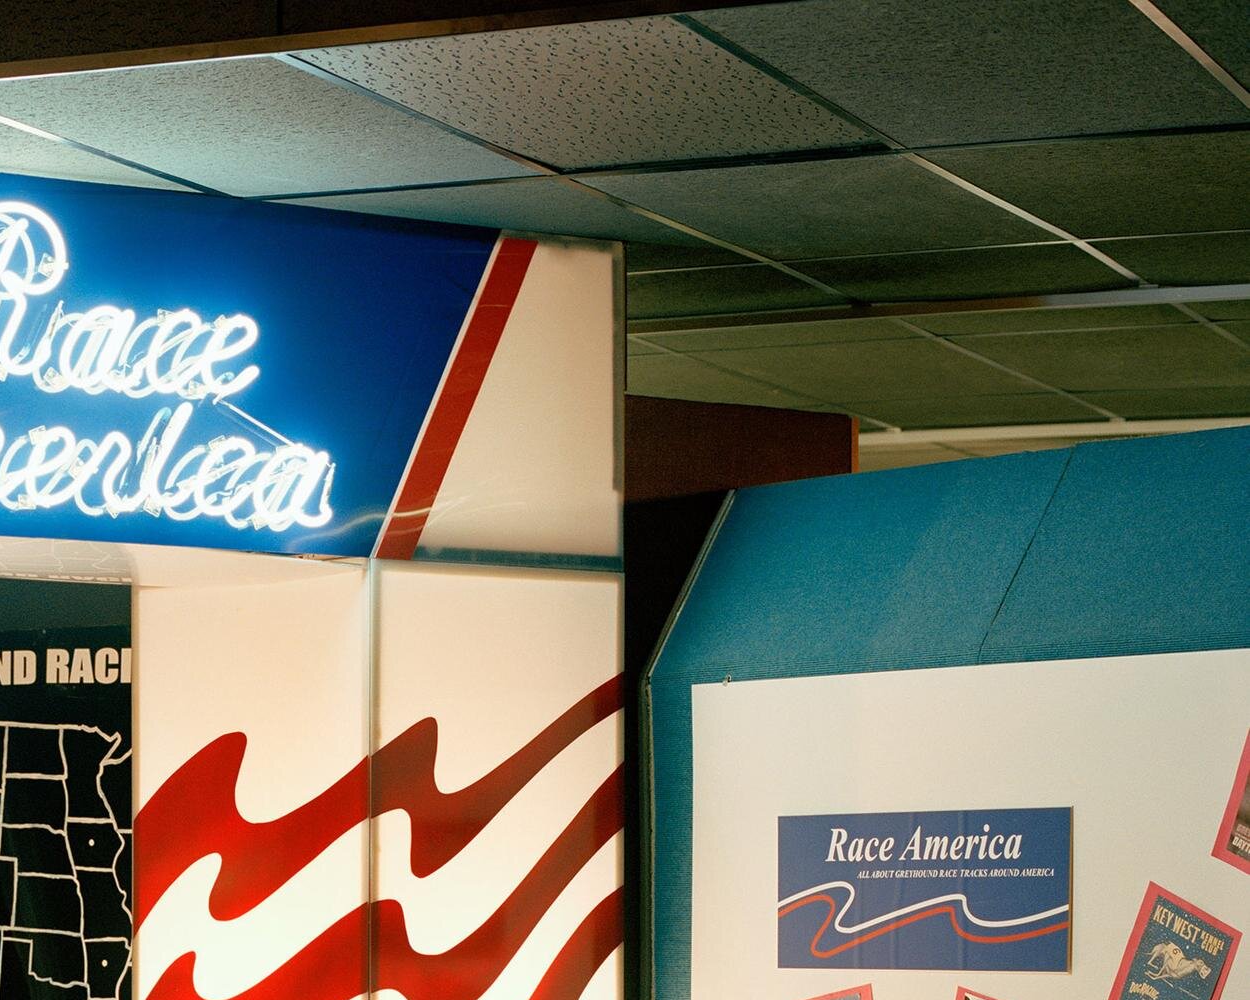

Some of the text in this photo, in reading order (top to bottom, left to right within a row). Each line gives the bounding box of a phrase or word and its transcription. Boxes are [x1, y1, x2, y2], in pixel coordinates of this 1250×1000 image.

[46, 647, 132, 685] RACI
[825, 823, 1023, 862] Race America
[857, 867, 1055, 879] ALL ABOUT GREYHOUND RACE TRACKS AROUND AMERICA
[1153, 904, 1225, 951] KEY WEST KENNEL
[1200, 941, 1219, 956] CLUB
